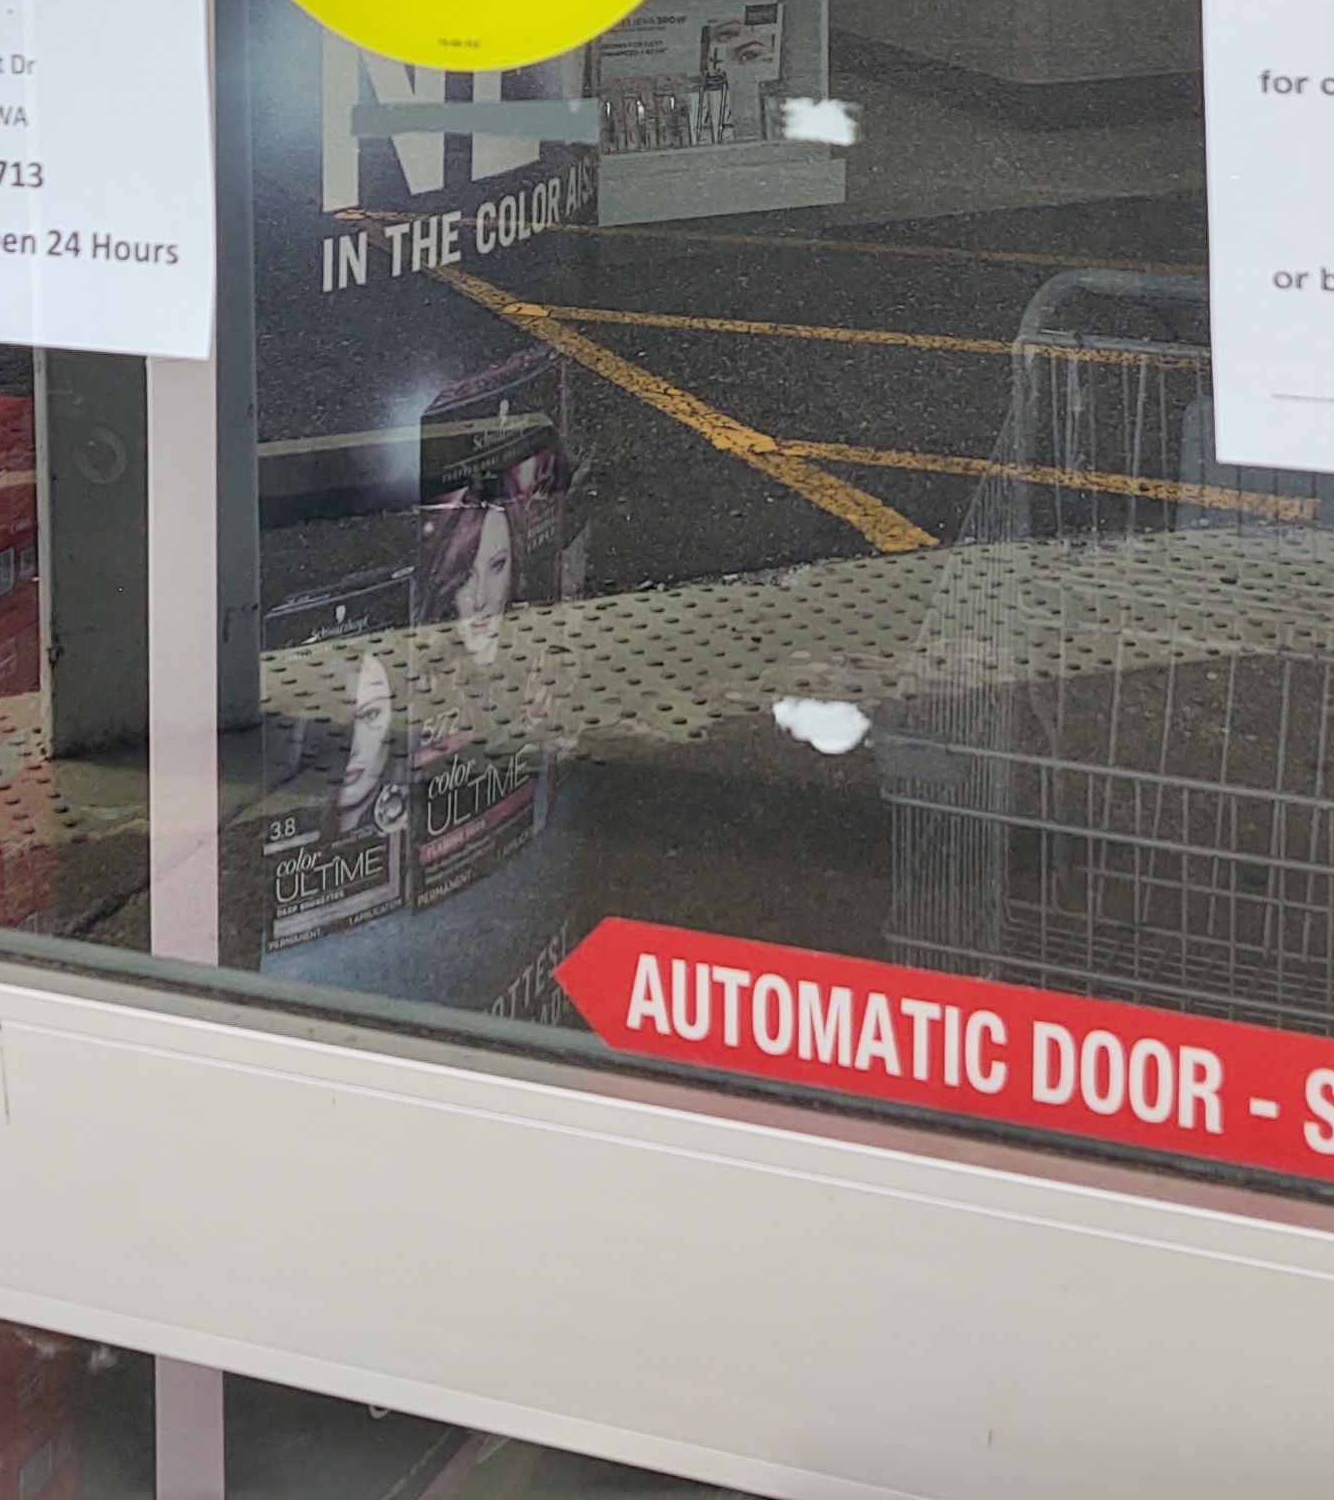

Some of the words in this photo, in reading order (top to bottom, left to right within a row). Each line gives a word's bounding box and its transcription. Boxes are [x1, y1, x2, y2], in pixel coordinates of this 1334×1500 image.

[619, 15, 687, 29] ELIEVABROW
[11, 54, 35, 76] Dr
[1259, 70, 1308, 96] for
[47, 231, 81, 258] 24
[92, 234, 179, 266] Hours
[322, 232, 367, 293] IN
[384, 211, 462, 278] THE
[476, 177, 561, 255] COLOR
[1272, 267, 1310, 292] or
[428, 753, 476, 800] color
[277, 847, 322, 877] color
[625, 952, 1007, 1094] AUTOMATIC
[1031, 1020, 1224, 1135] DOOR
[1249, 1097, 1277, 1121] -
